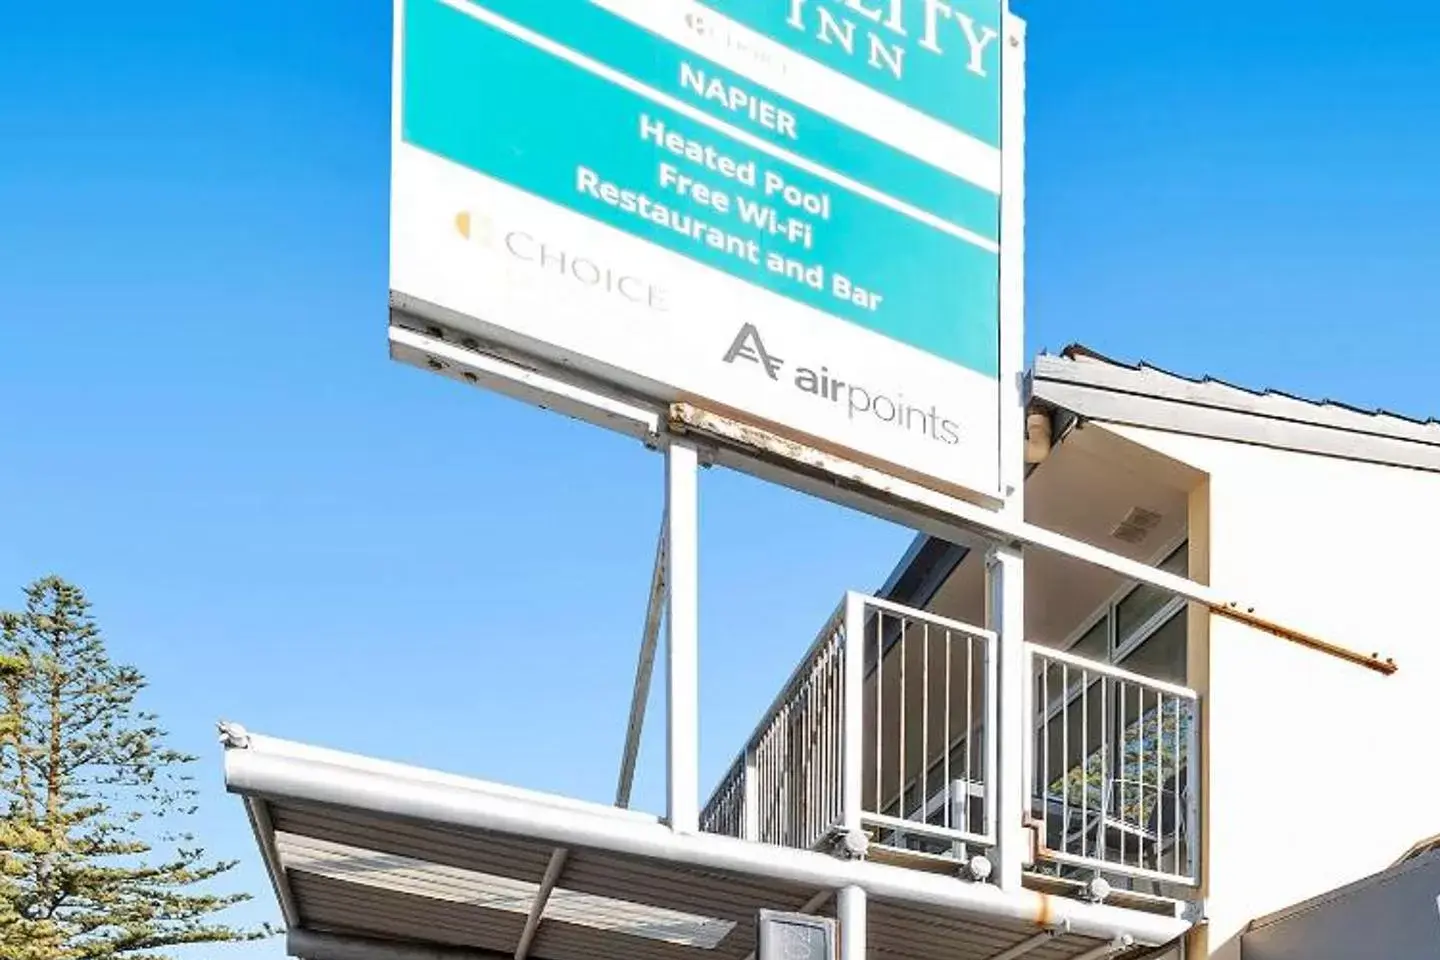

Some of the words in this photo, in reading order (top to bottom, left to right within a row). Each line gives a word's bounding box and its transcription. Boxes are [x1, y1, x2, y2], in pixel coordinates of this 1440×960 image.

[787, 0, 905, 80] INN
[680, 61, 797, 140] NAPIER
[639, 113, 756, 187] Heated
[764, 170, 830, 219] Pool
[658, 162, 729, 213] Free
[737, 195, 813, 249] Wi-Fi
[504, 230, 670, 311] CHOICE
[576, 165, 760, 264] Restaurant
[766, 251, 824, 291] and
[832, 272, 883, 311] Bar
[794, 365, 959, 445] airpoints
